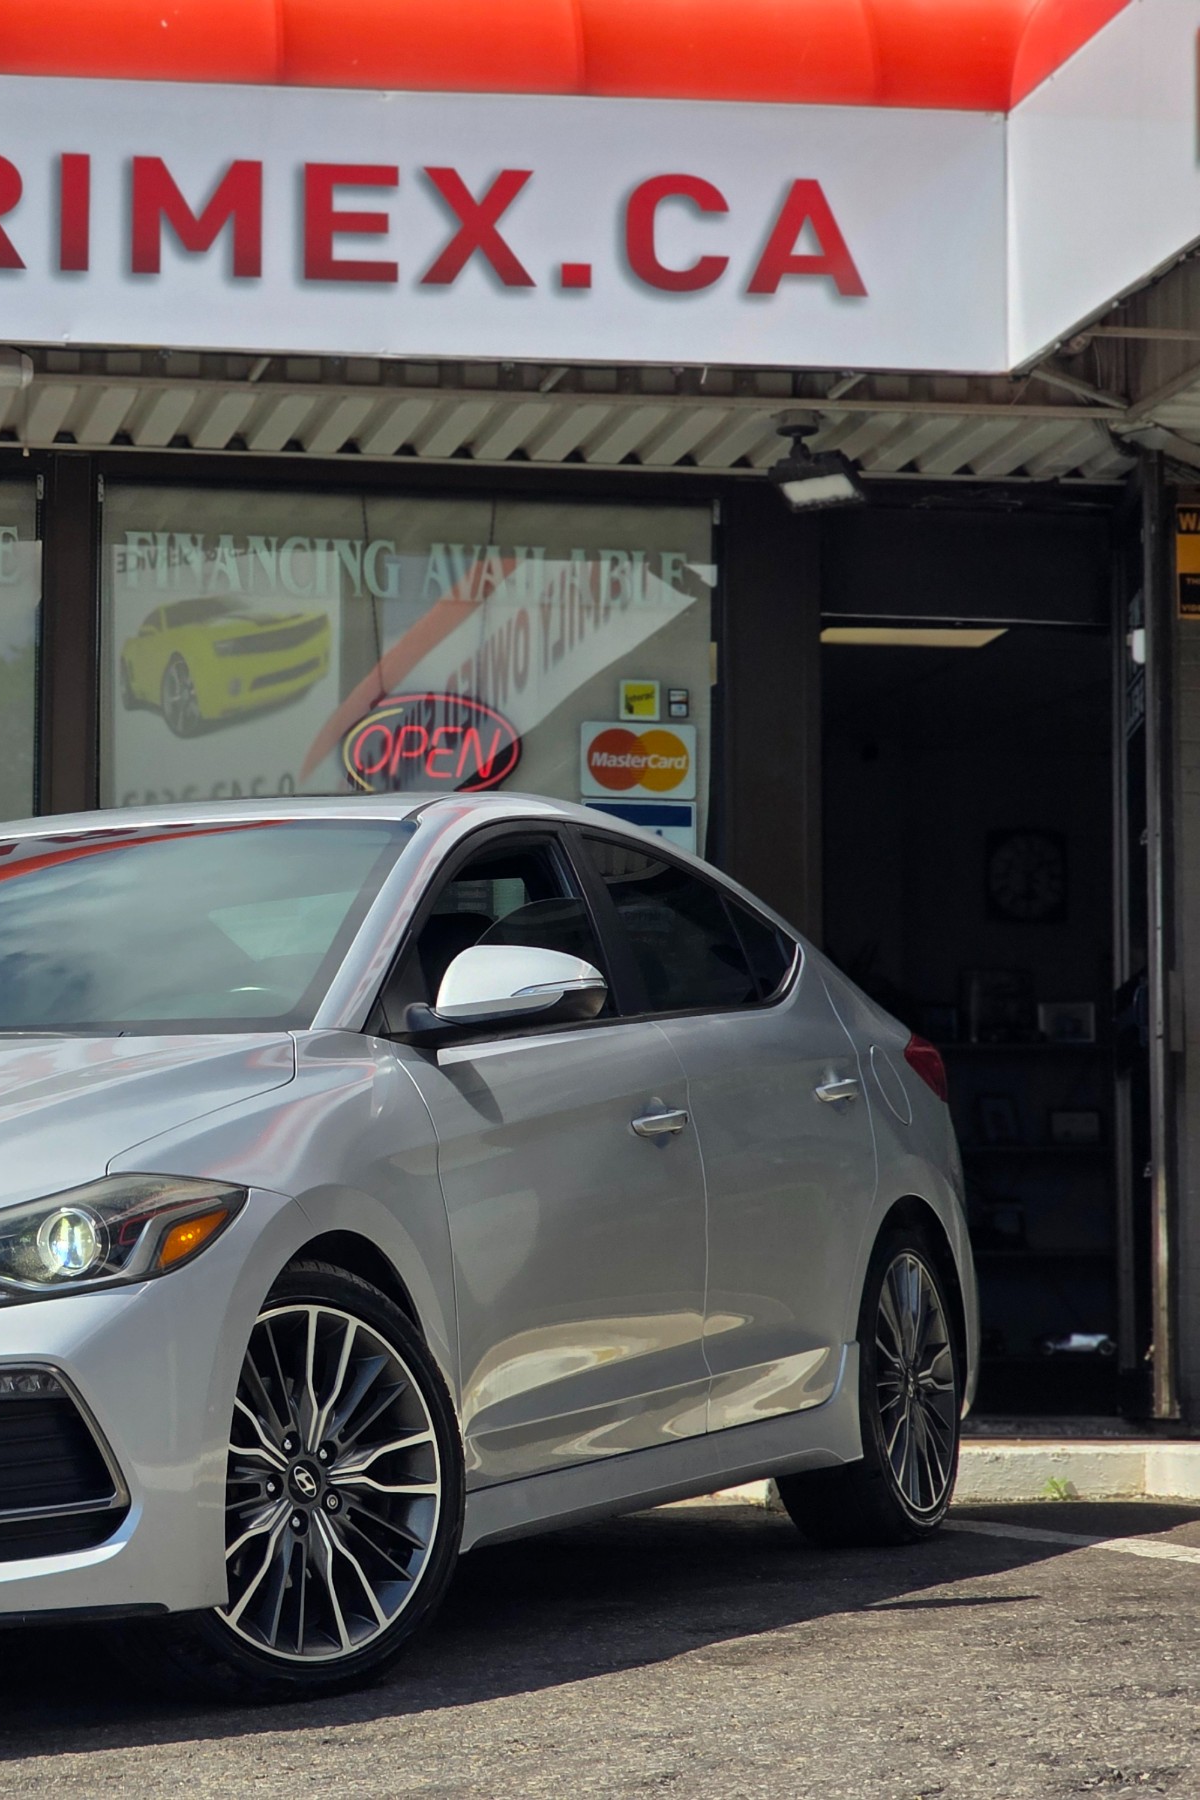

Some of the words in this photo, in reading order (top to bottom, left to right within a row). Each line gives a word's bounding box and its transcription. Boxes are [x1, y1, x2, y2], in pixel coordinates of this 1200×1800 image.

[123, 531, 397, 598] FINANCING
[421, 543, 690, 603] AVAILABLE
[352, 724, 500, 779] OPEN
[590, 751, 688, 770] MasterCard
